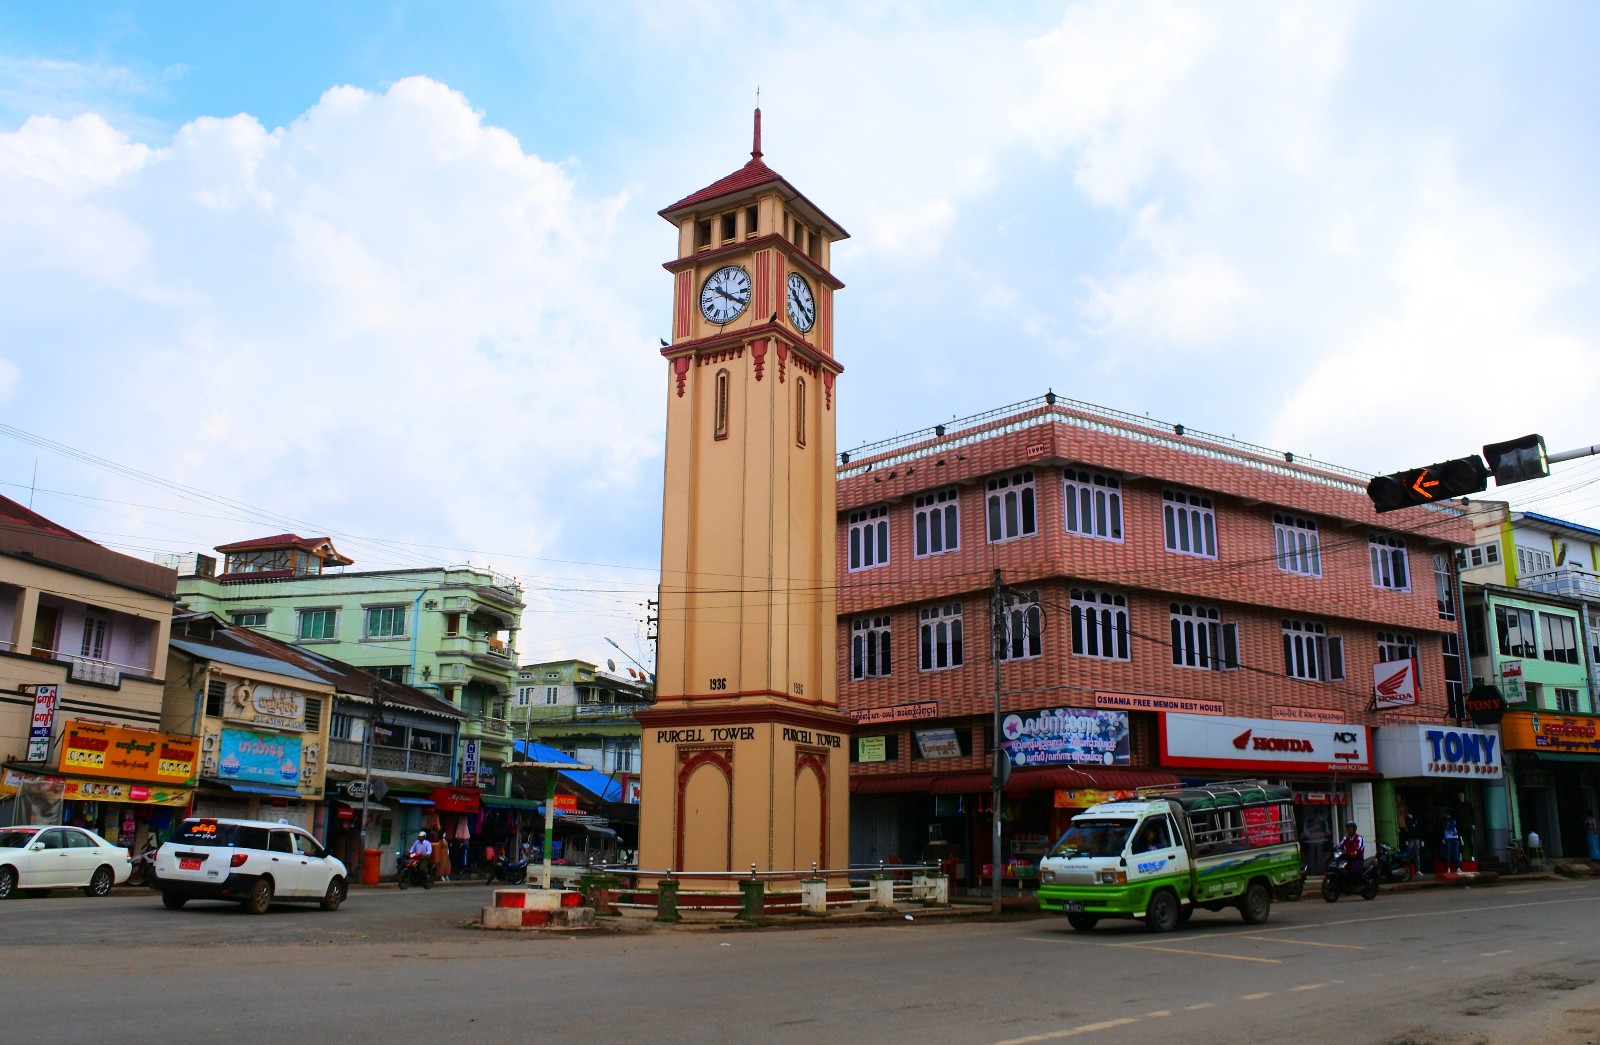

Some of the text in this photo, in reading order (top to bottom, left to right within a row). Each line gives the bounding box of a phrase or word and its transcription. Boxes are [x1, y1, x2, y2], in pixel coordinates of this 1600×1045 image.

[709, 677, 727, 691] 1936
[1097, 695, 1223, 713] OSMANIA FREE MEMON REST HOUSE
[1378, 693, 1413, 703] HONDA
[1466, 699, 1502, 711] TONY
[657, 727, 755, 743] PURCELL TOWER
[782, 728, 841, 748] PURCELL TOWER
[1253, 737, 1314, 753] HONDA
[1426, 730, 1496, 765] TONY
[1474, 765, 1499, 775] SHOP
